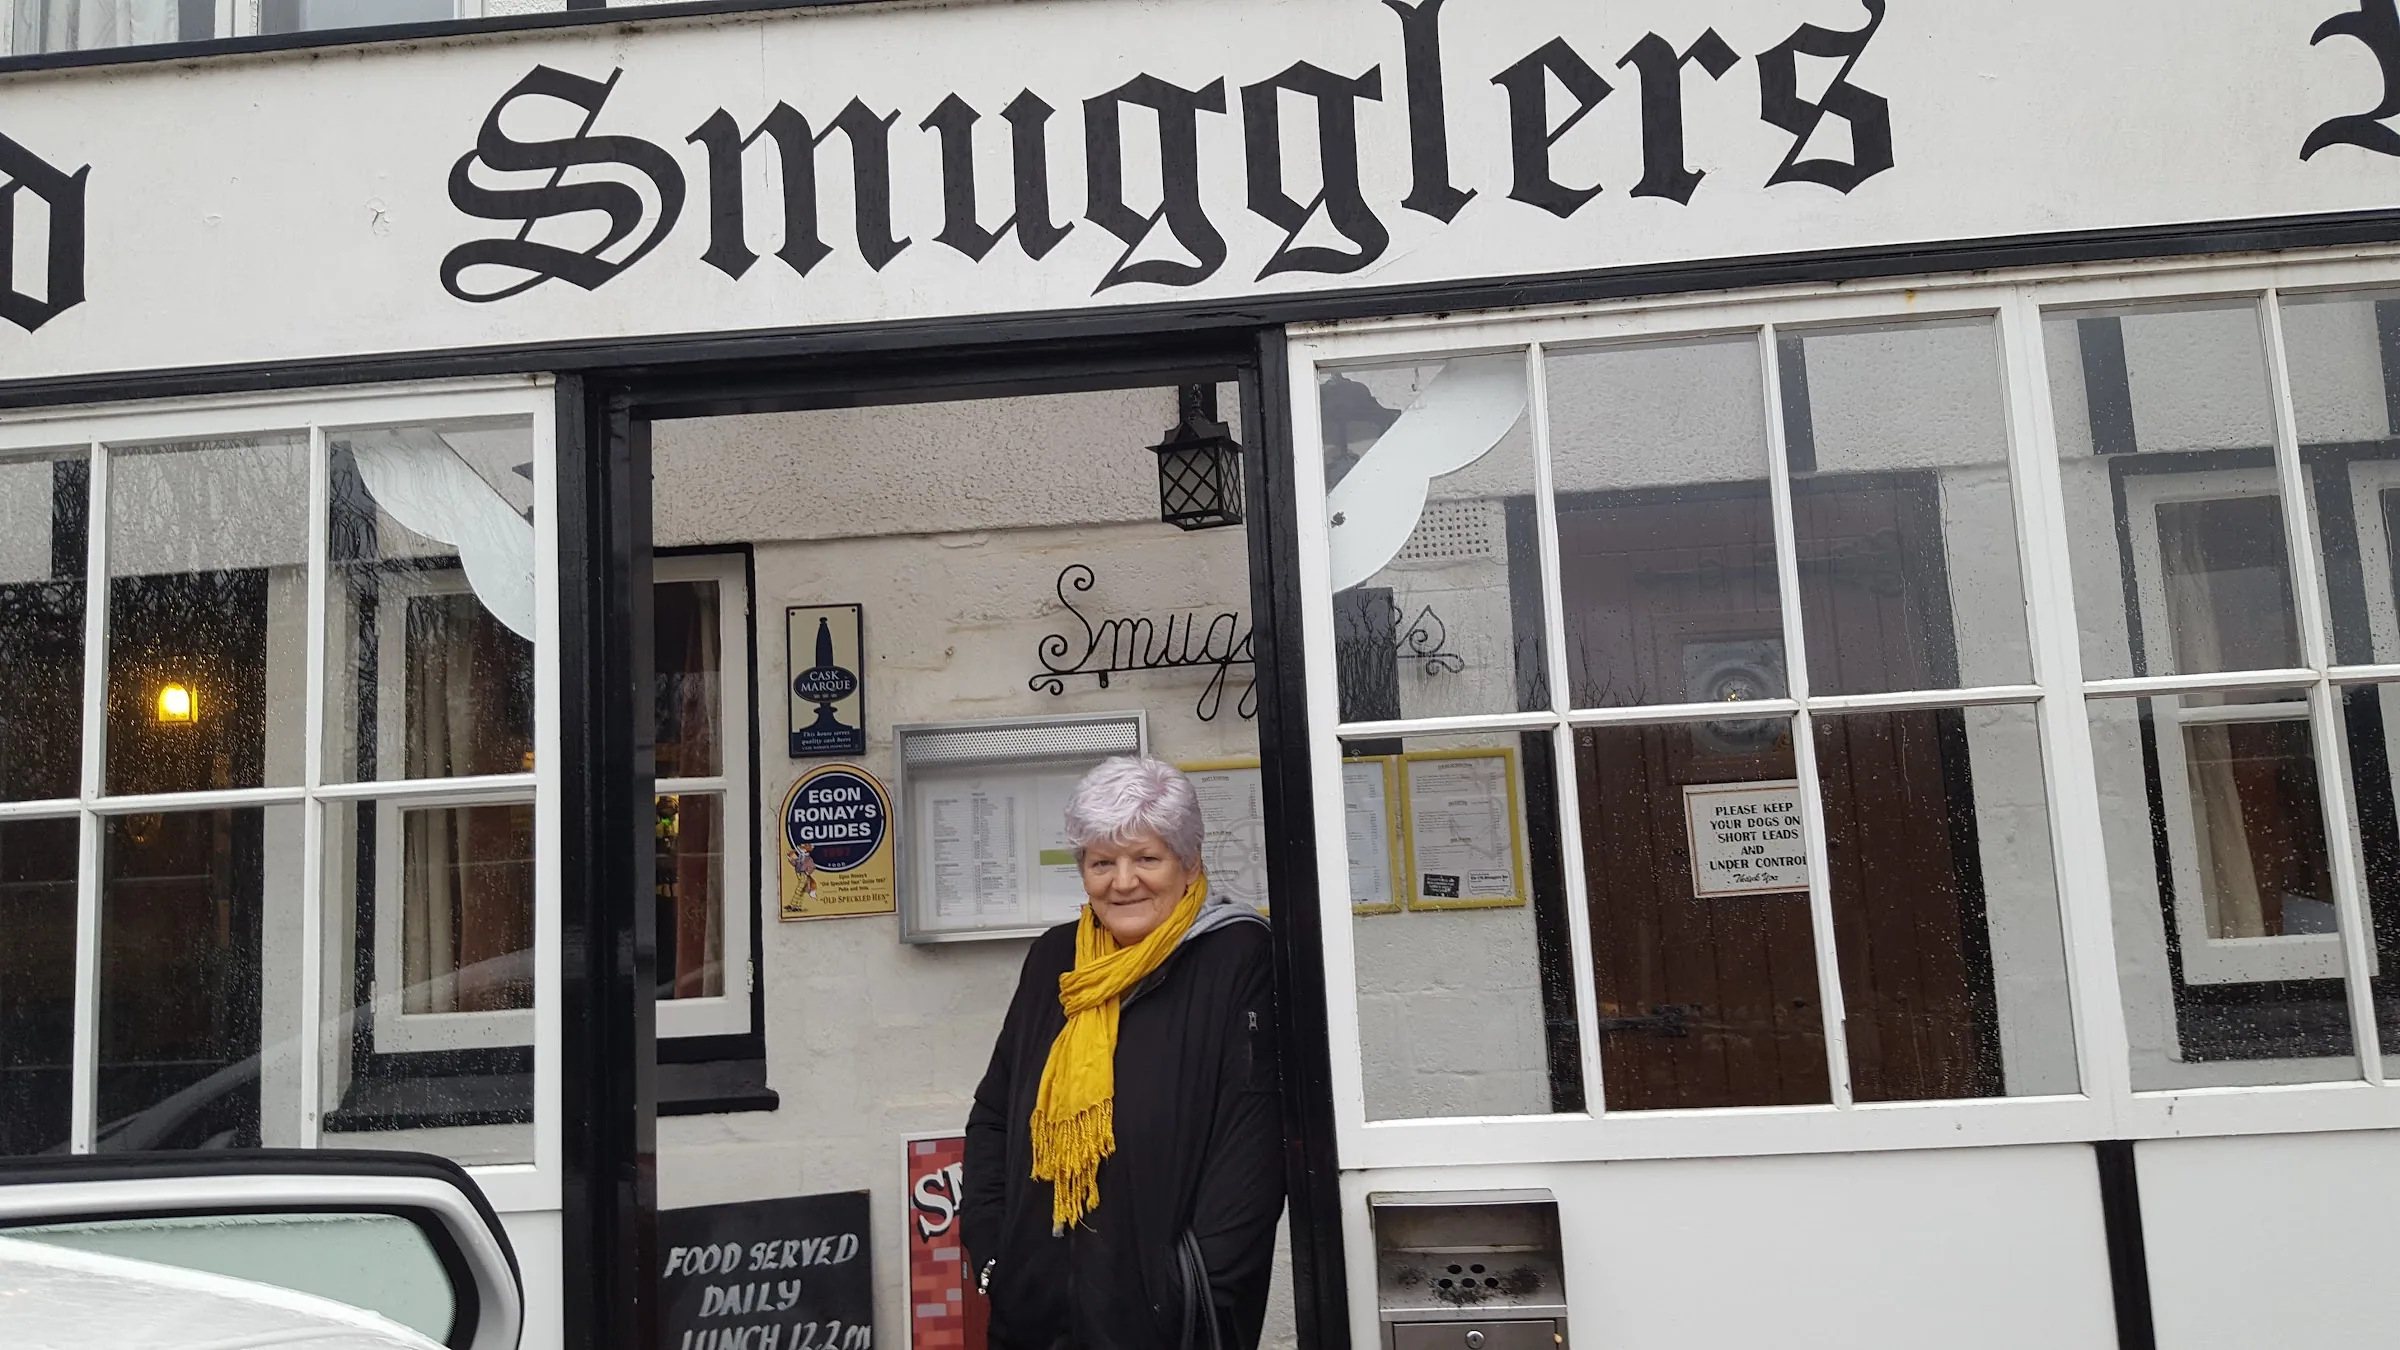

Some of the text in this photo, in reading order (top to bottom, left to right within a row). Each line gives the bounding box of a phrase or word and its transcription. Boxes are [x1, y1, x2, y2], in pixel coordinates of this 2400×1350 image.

[439, 0, 1894, 304] Smugglers
[809, 670, 840, 681] CASK
[800, 680, 850, 692] MARQUE
[808, 787, 861, 803] EGON
[794, 804, 877, 823] RONAY'S
[1715, 802, 1793, 816] PLEASE KEEP
[1709, 815, 1801, 830] YOUR DOGS ON
[800, 822, 872, 840] GUIDES
[1717, 828, 1799, 844] SHORT LEADS
[1741, 845, 1765, 856] AND
[1709, 859, 1749, 871] UNDER
[1733, 872, 1779, 884] Thank You
[838, 895, 872, 904] SPECKLED
[663, 1233, 859, 1279] FOOD SERVED
[698, 1278, 802, 1318] DAILY
[681, 1323, 782, 1350] LUNCH
